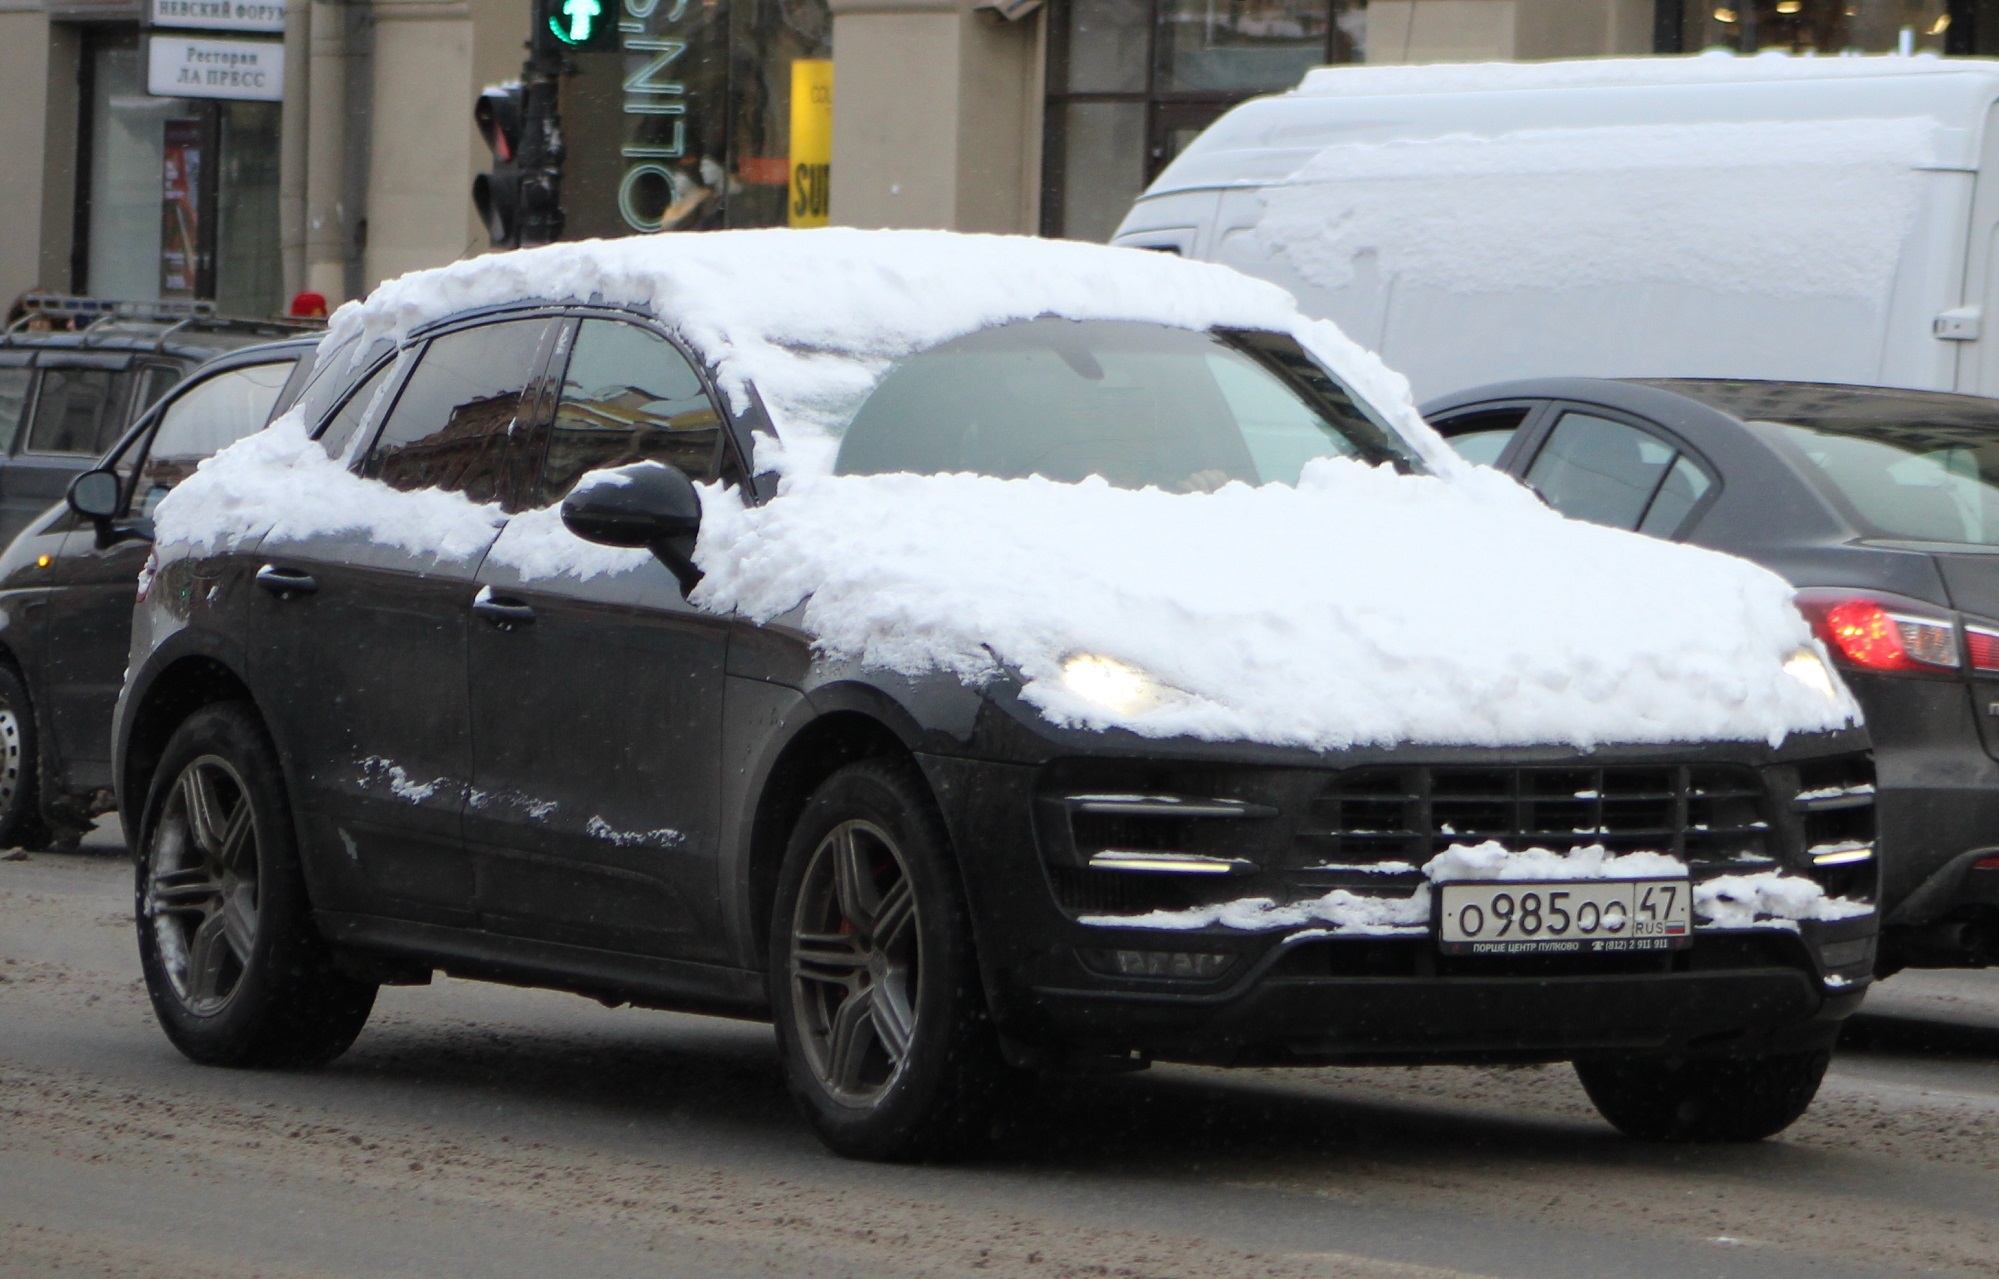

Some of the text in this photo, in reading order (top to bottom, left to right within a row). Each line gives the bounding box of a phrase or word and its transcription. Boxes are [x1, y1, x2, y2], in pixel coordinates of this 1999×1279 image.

[159, 1, 231, 18] НЕВСКИЙ
[186, 47, 258, 68] Ресторан
[177, 68, 265, 87] ЛА ПРЕСС
[1639, 886, 1676, 921] 47
[1635, 921, 1664, 935] RUS
[1473, 939, 1668, 953] ПОРШЕ ЦЕНТР ПУЛКОВО (812) 2 911 911
